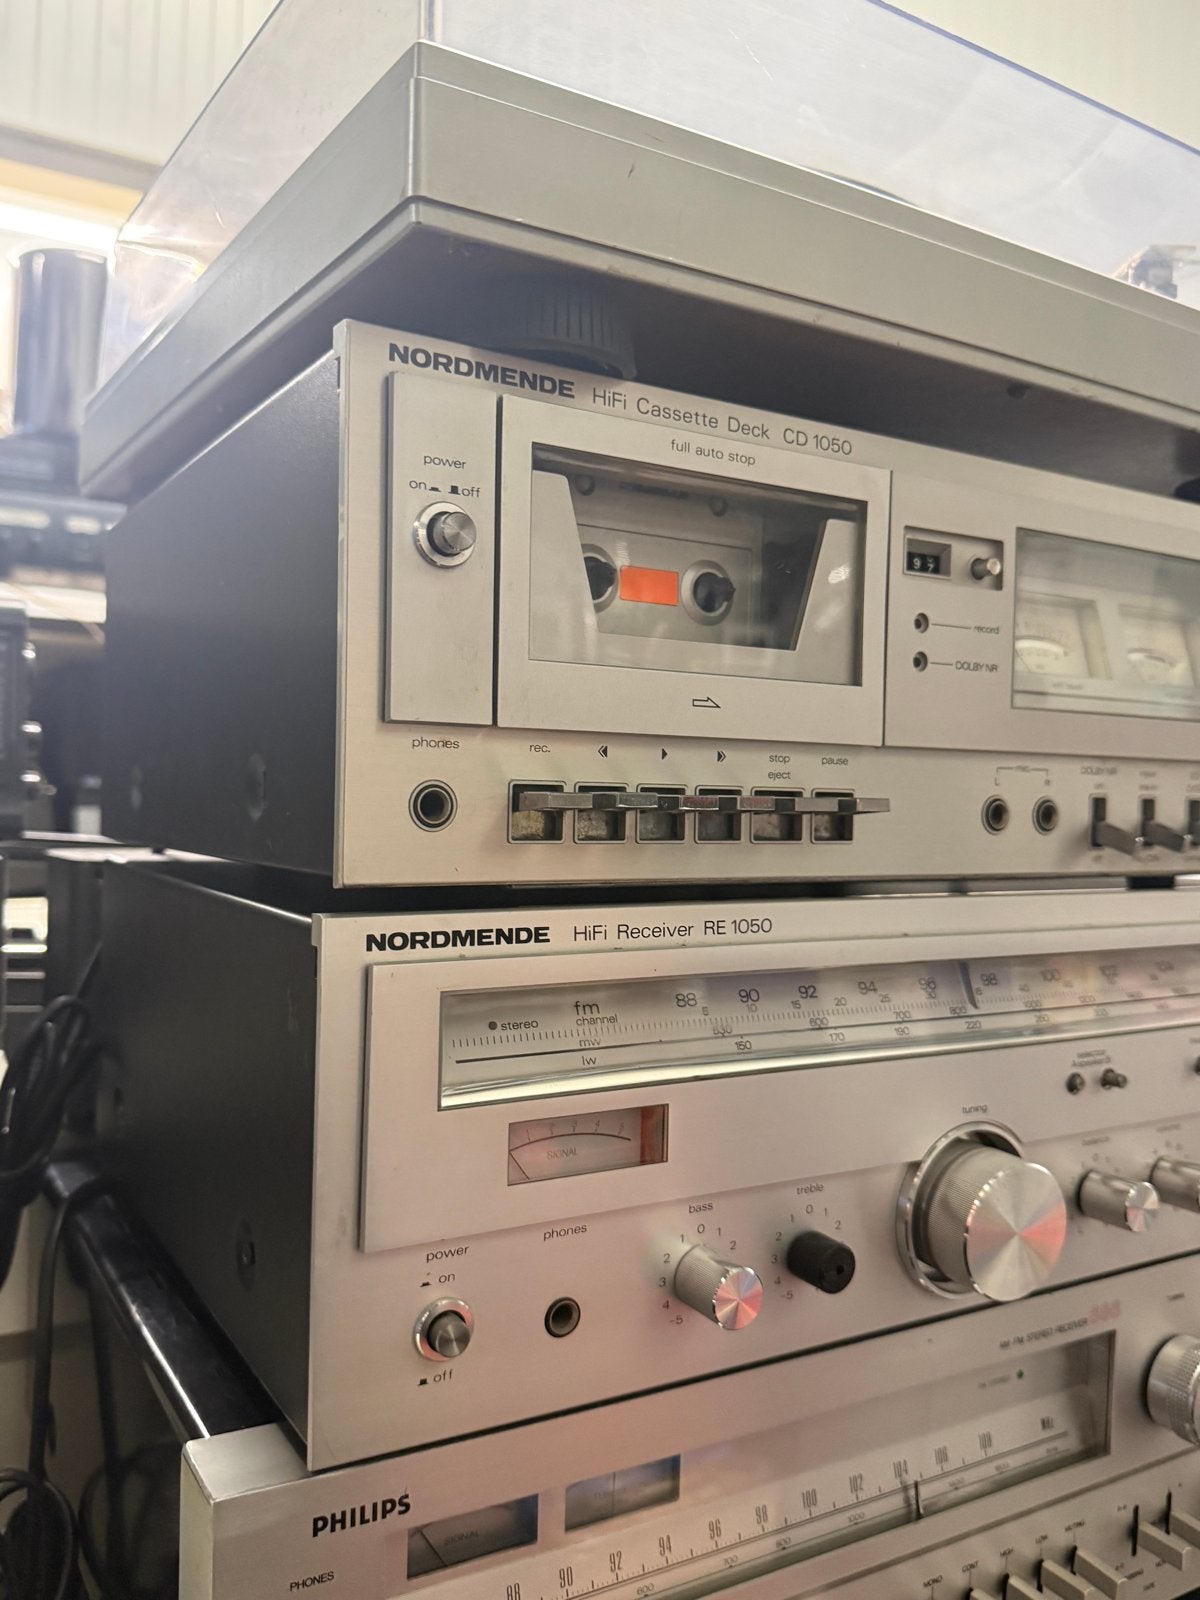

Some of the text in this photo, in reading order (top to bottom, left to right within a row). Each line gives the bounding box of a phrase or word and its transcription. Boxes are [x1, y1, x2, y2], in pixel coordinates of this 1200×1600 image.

[388, 342, 576, 399] NORDMENDE
[592, 387, 853, 456] HiFi Cassette Deck CD 1050
[670, 438, 756, 467] full auto stop
[423, 454, 467, 470] power
[408, 479, 481, 498] on off
[973, 624, 1000, 635] record
[955, 660, 999, 673] DOLBY NR
[411, 736, 460, 750] phones
[529, 742, 551, 754] rec.
[768, 752, 791, 764] stop
[821, 756, 849, 767] pause
[767, 769, 791, 780] eject
[573, 917, 773, 942] HiFi Receiver RE 1050
[365, 926, 551, 952] NORDMENDE
[573, 1000, 601, 1016] fm
[675, 992, 697, 1008] 88
[738, 988, 760, 1003] 90
[798, 984, 818, 999] 92
[858, 980, 878, 995] 94
[575, 1013, 619, 1027] channel
[746, 1003, 758, 1013] 10
[834, 996, 848, 1007] 20
[500, 1018, 539, 1032] stereo
[578, 1038, 602, 1048] mw
[893, 1010, 912, 1020] 700
[581, 1054, 597, 1066] lw
[734, 1039, 753, 1051] 150
[828, 1031, 846, 1042] 170
[964, 1020, 982, 1030] 220
[962, 1104, 988, 1115] tuning
[546, 1147, 578, 1160] SIGNAL
[796, 1182, 825, 1196] treble
[688, 1201, 714, 1214] bass
[805, 1204, 814, 1215] 0
[834, 1220, 842, 1230] 2
[542, 1223, 588, 1242] phones
[697, 1223, 705, 1235] 0
[729, 1240, 737, 1250] 2
[775, 1231, 782, 1242] 2
[425, 1244, 470, 1264] power
[663, 1253, 671, 1264] 2
[771, 1254, 779, 1264] 3
[438, 1271, 456, 1284] on
[658, 1277, 667, 1288] 3
[773, 1276, 782, 1286] 4
[661, 1300, 671, 1311] 4
[432, 1368, 454, 1383] off
[311, 1493, 412, 1538] PHILIPS
[558, 1565, 574, 1588] 90
[608, 1550, 623, 1572] 92
[658, 1534, 673, 1557] 94
[708, 1518, 722, 1540] 96
[755, 1503, 769, 1525] 98
[801, 1487, 818, 1509] 100
[288, 1570, 335, 1593] PHONES
